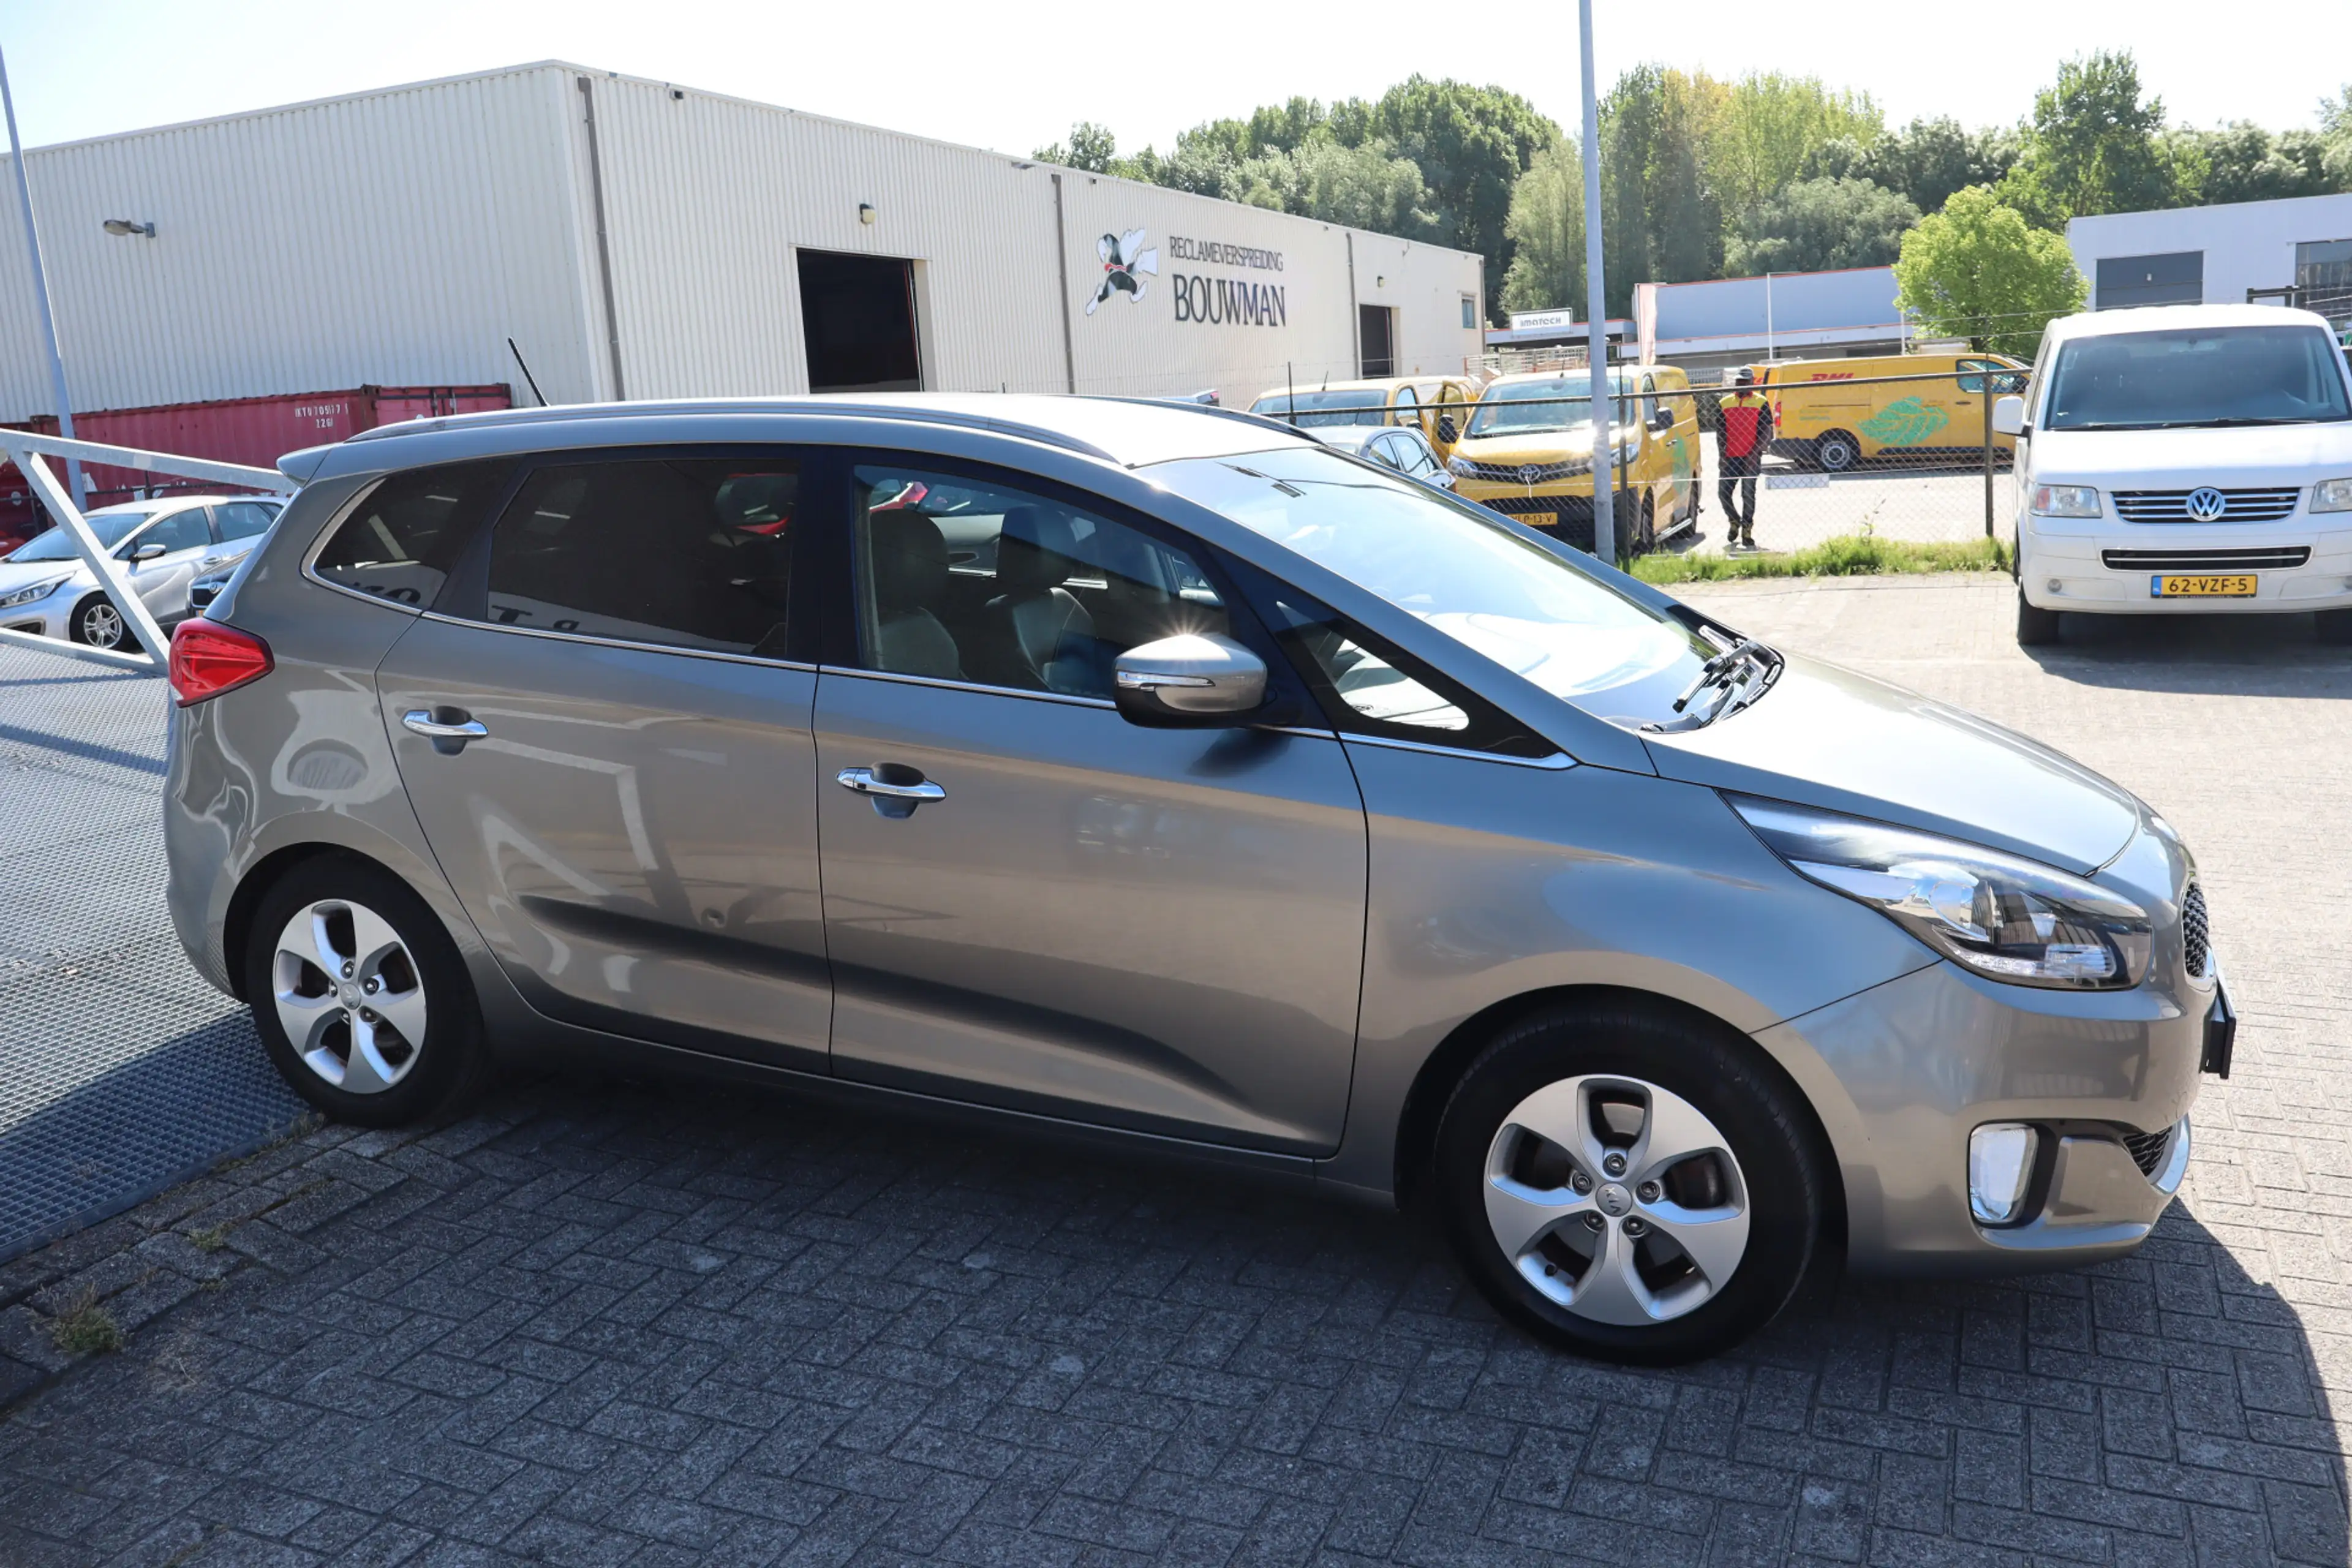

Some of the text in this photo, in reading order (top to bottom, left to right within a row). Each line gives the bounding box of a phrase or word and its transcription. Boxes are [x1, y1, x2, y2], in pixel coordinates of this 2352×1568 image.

[1169, 236, 1284, 271] RECLAMEVERSPREIDING
[1172, 274, 1286, 327] BOUWMAN
[2169, 578, 2247, 592] 62-VZF-5
